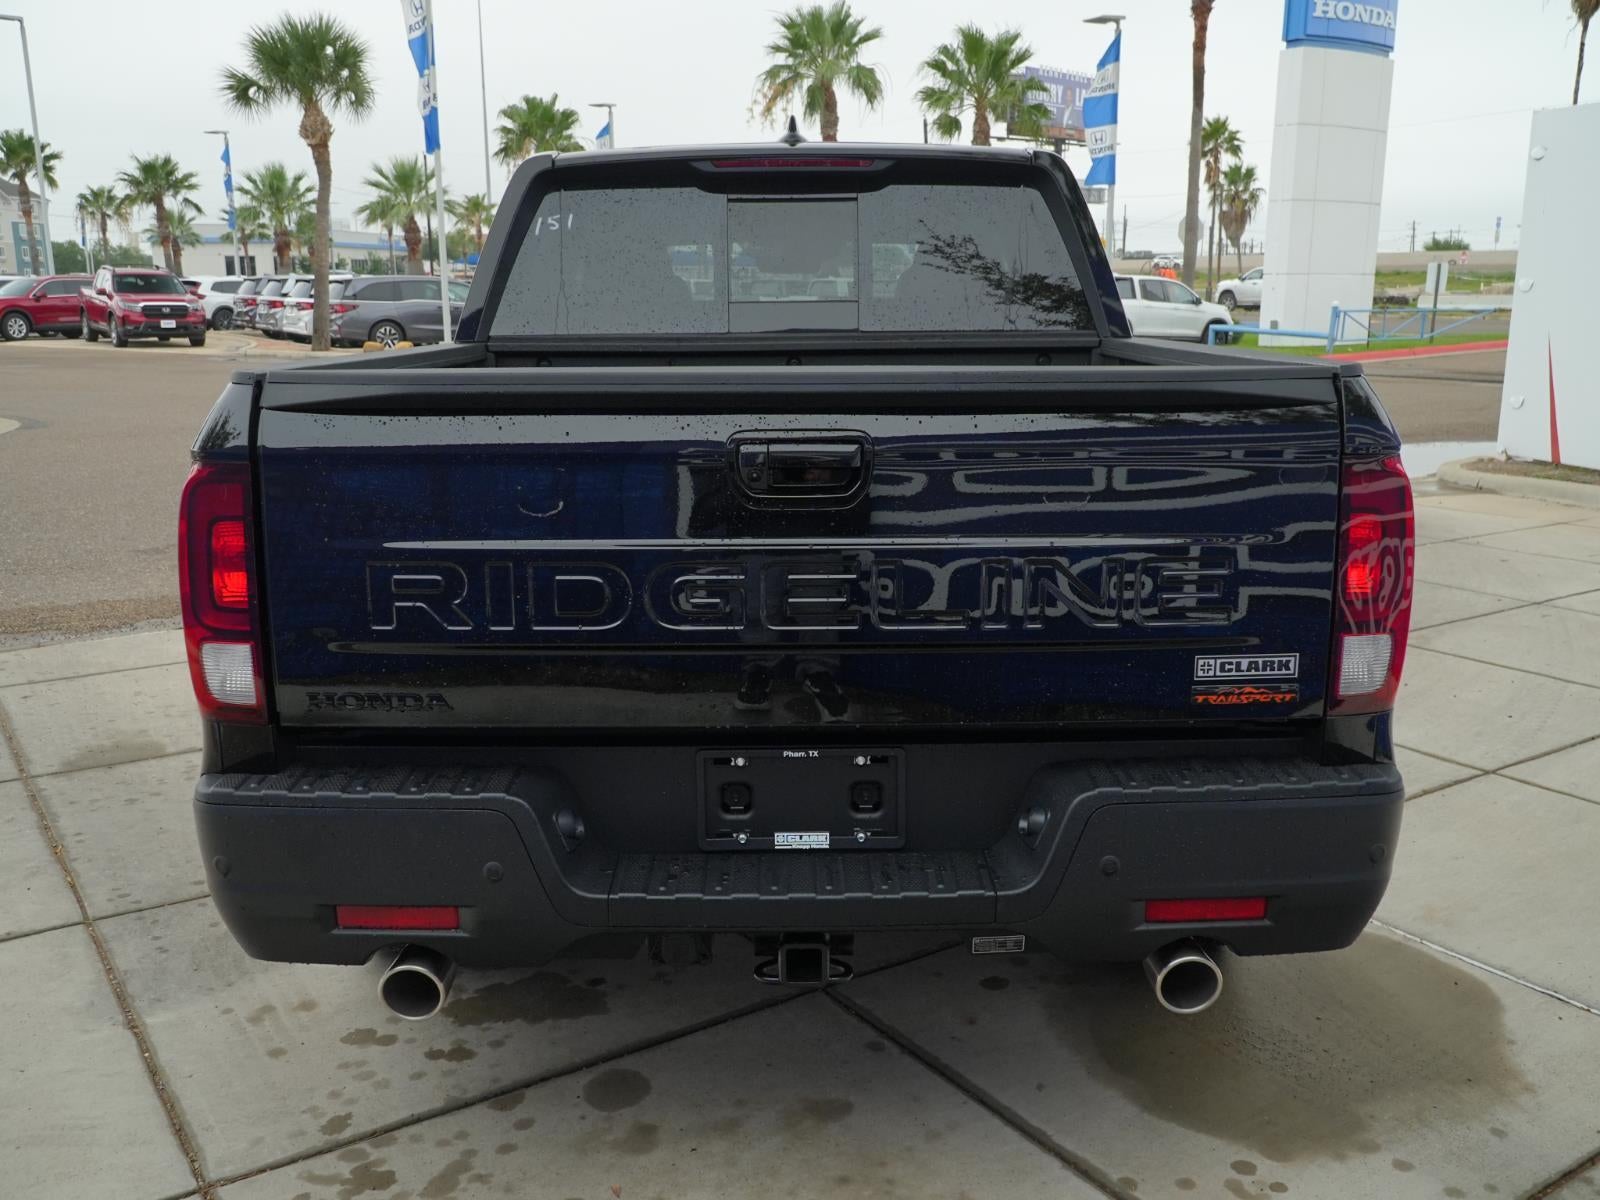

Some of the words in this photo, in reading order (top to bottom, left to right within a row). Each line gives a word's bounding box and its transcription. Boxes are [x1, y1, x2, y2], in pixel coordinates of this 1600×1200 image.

[1313, 0, 1395, 28] HONDA
[535, 213, 573, 235] 151
[366, 557, 1233, 631] RIDGELINE
[1219, 660, 1292, 673] CLARK
[305, 691, 454, 711] HONDA
[1194, 693, 1297, 704] TRAILSPORT
[808, 750, 819, 758] TX
[787, 834, 827, 843] CLARK
